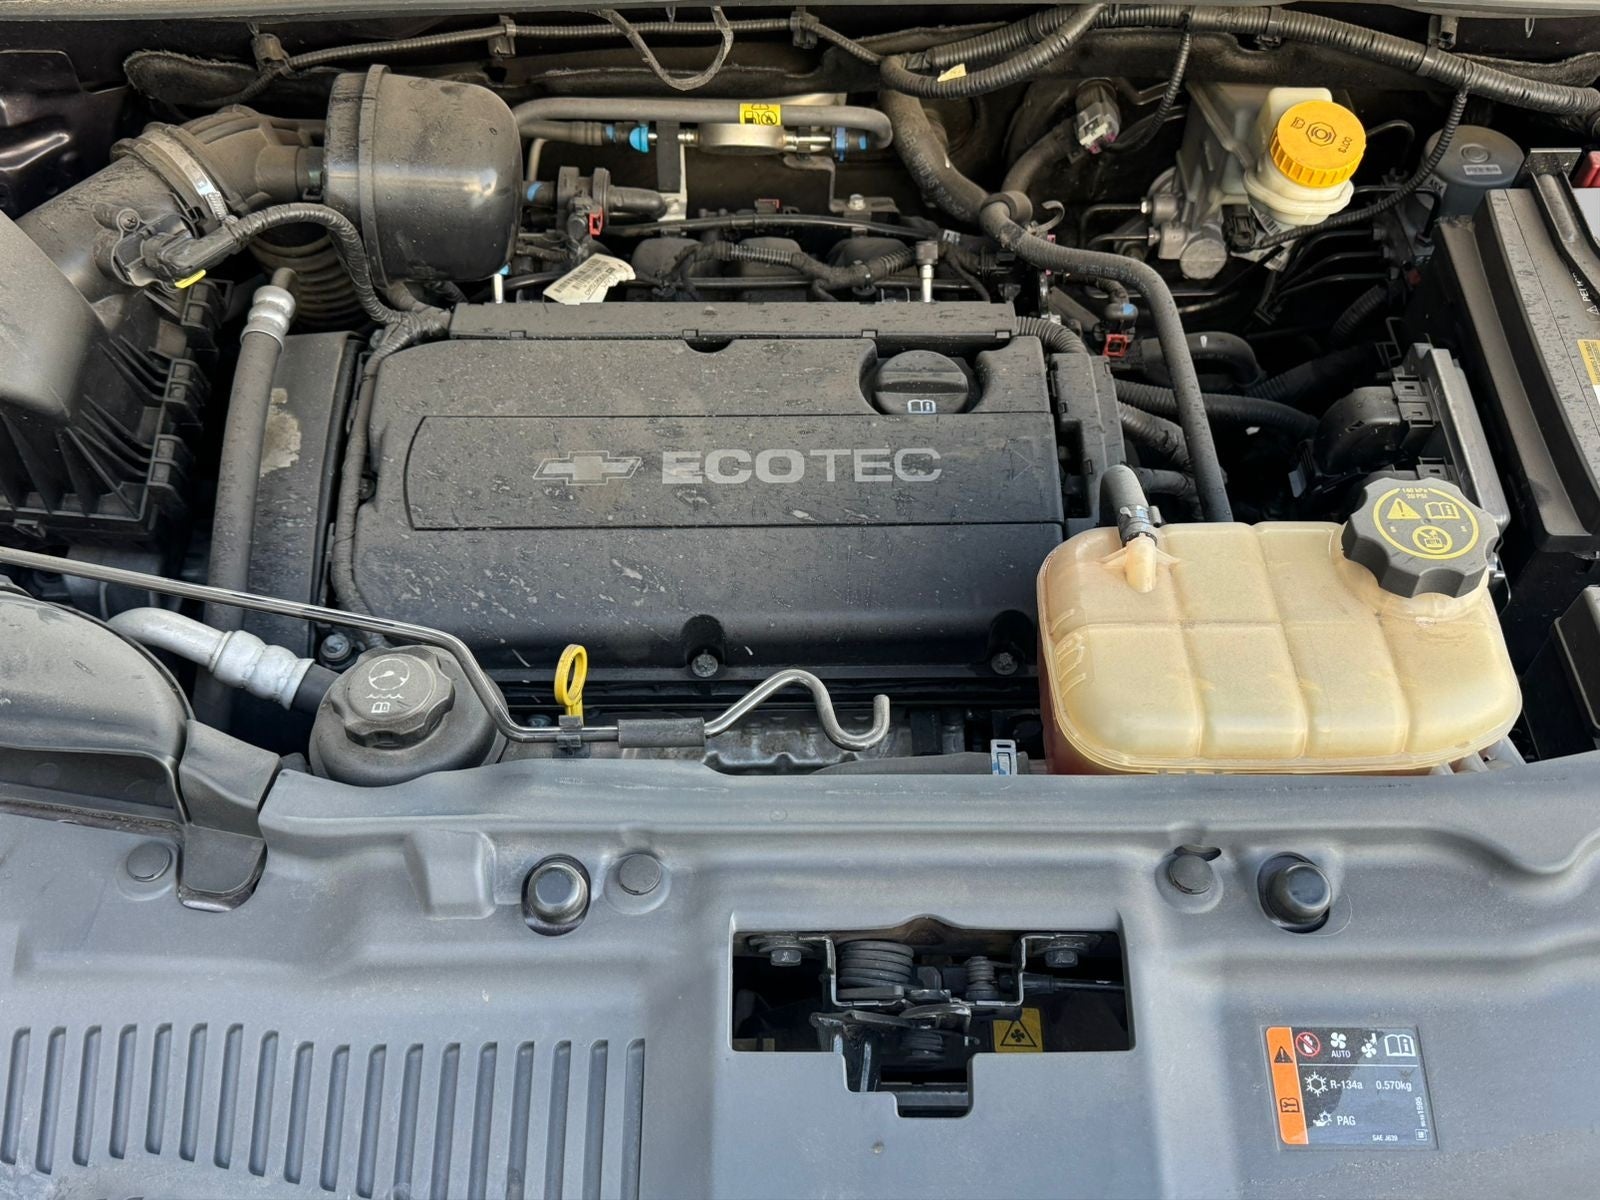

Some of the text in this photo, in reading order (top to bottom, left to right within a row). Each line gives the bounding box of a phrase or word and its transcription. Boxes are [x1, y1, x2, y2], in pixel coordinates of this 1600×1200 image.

[662, 447, 942, 485] ECOTEC
[1331, 1050, 1351, 1058] AUTO
[1330, 1080, 1412, 1092] R-134a 0.570kg
[1337, 1115, 1356, 1126] PAG
